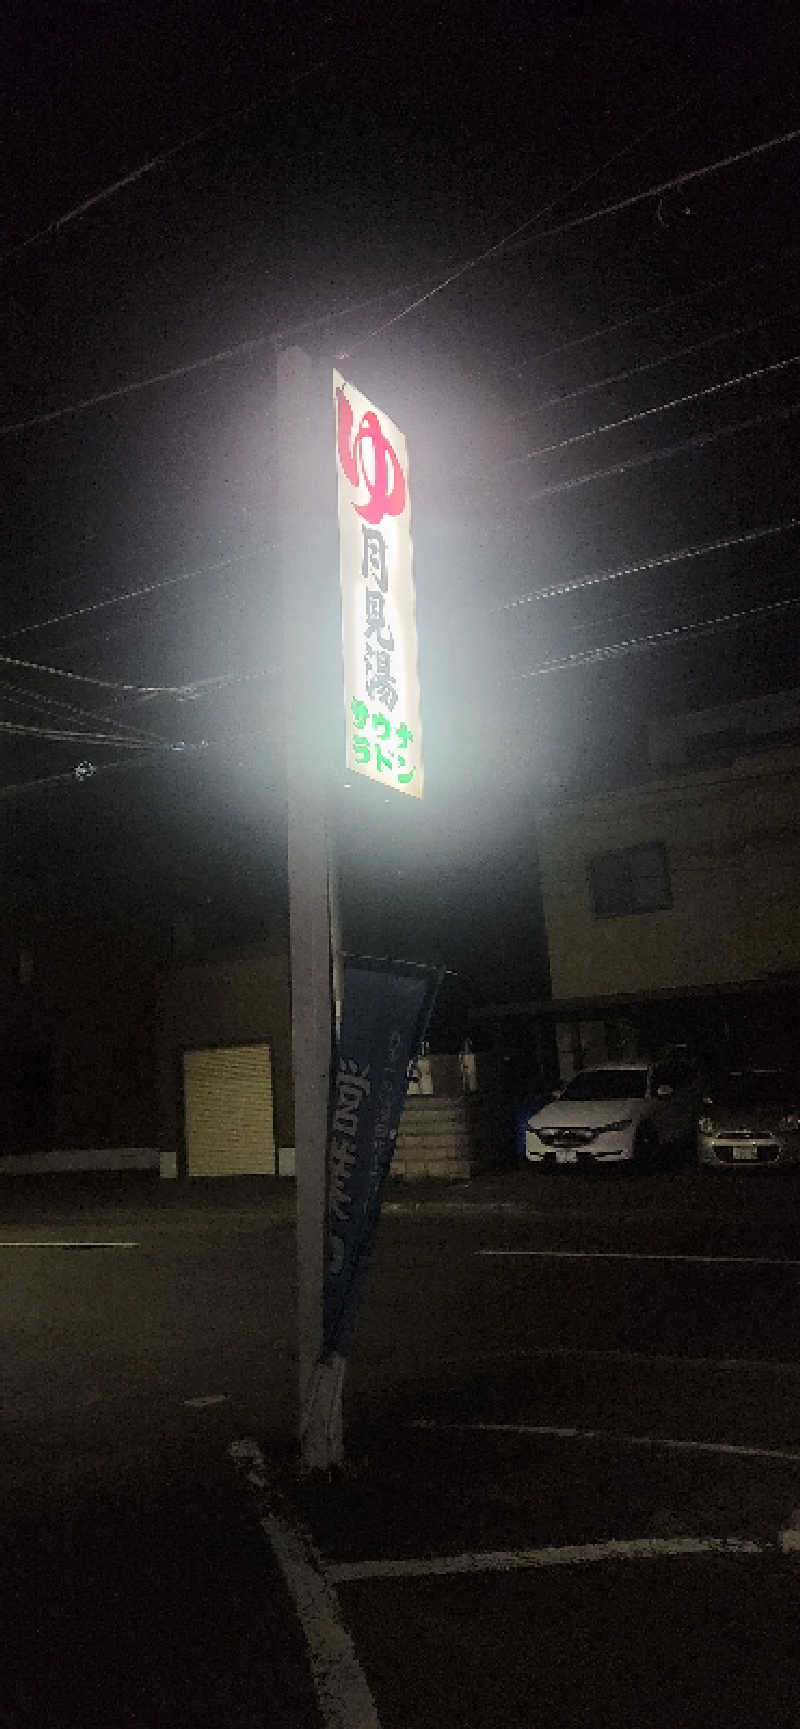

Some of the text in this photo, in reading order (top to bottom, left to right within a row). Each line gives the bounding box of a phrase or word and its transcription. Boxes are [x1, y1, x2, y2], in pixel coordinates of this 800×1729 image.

[361, 524, 398, 713] 月見湯
[351, 696, 416, 749] サウナ
[352, 735, 416, 784] ラドン
